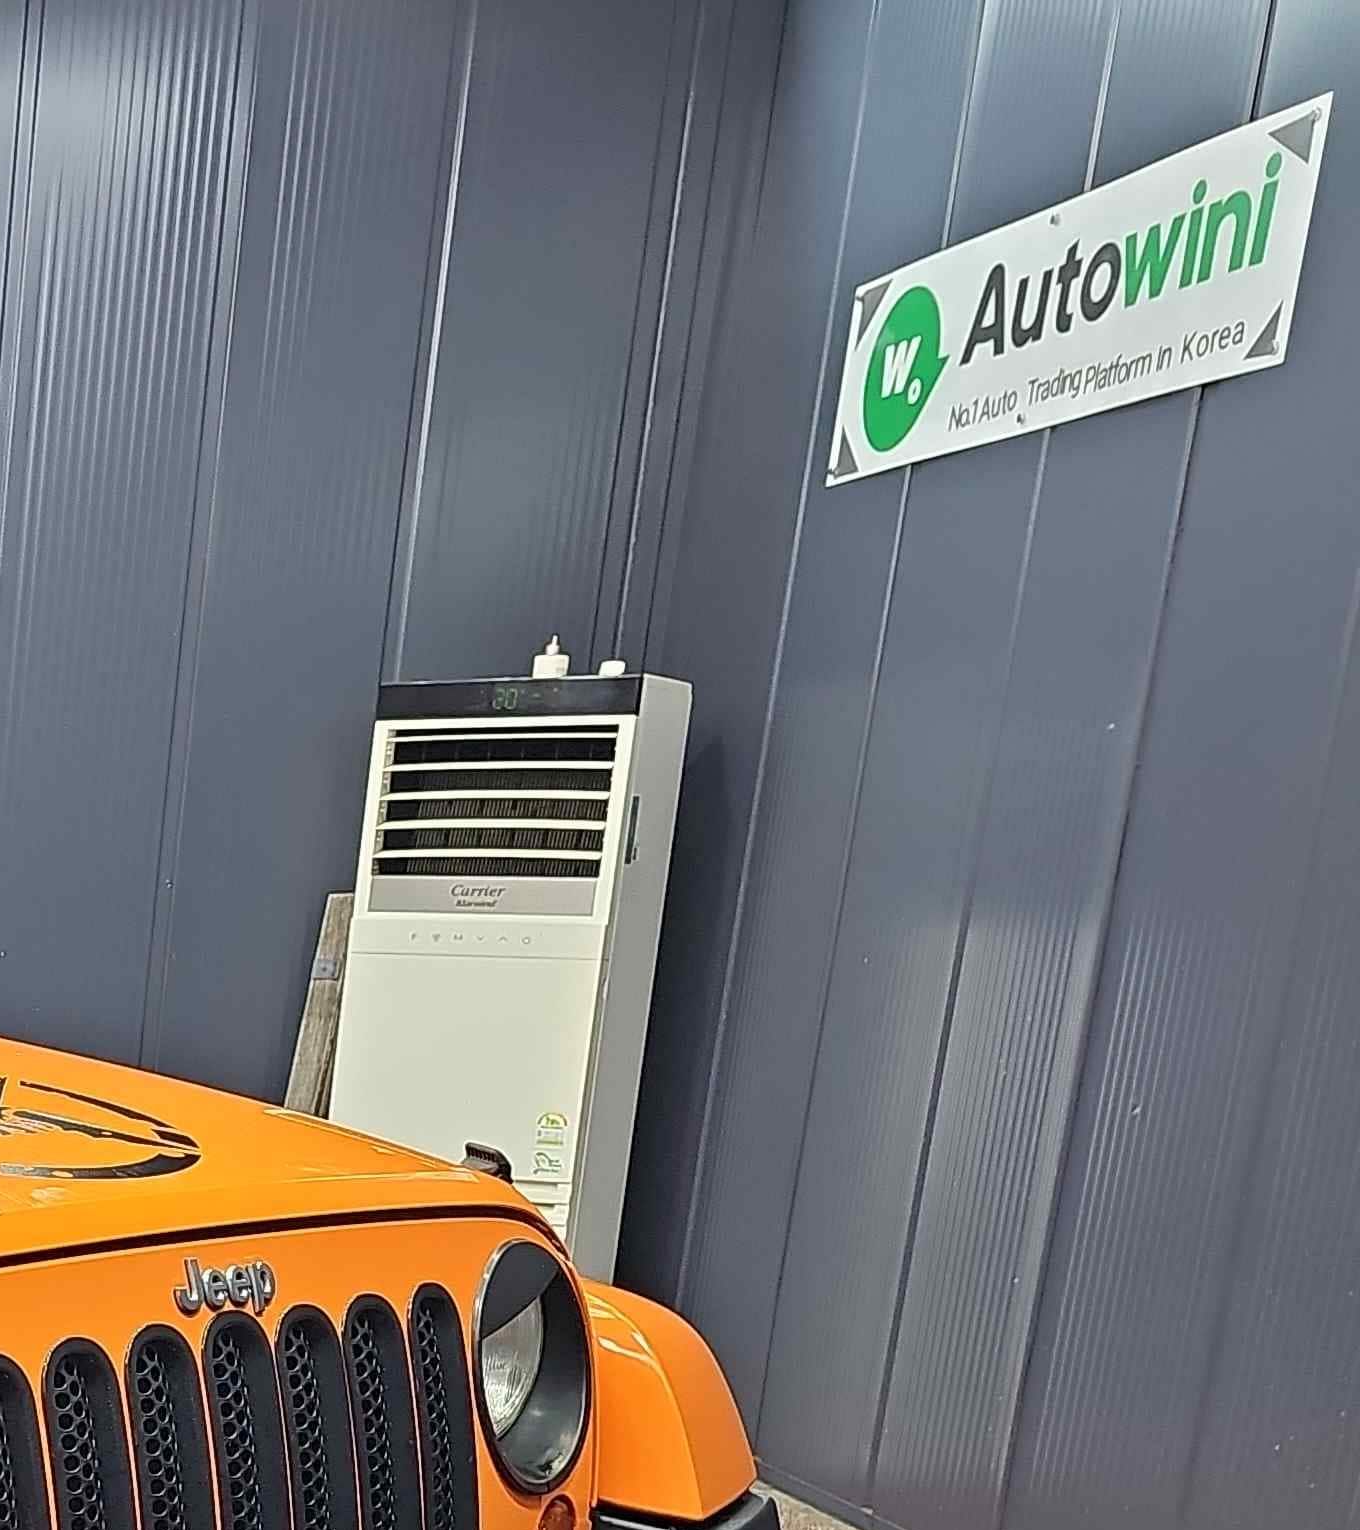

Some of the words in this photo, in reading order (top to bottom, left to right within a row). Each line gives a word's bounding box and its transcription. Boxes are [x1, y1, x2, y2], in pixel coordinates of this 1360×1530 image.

[960, 152, 1283, 367] Autowini
[979, 389, 1019, 424] Auto
[1029, 367, 1082, 407] Trading
[1082, 351, 1152, 396] Platform
[1180, 320, 1246, 364] Korea
[450, 883, 506, 898] Carrier
[173, 1257, 276, 1317] Jeep
